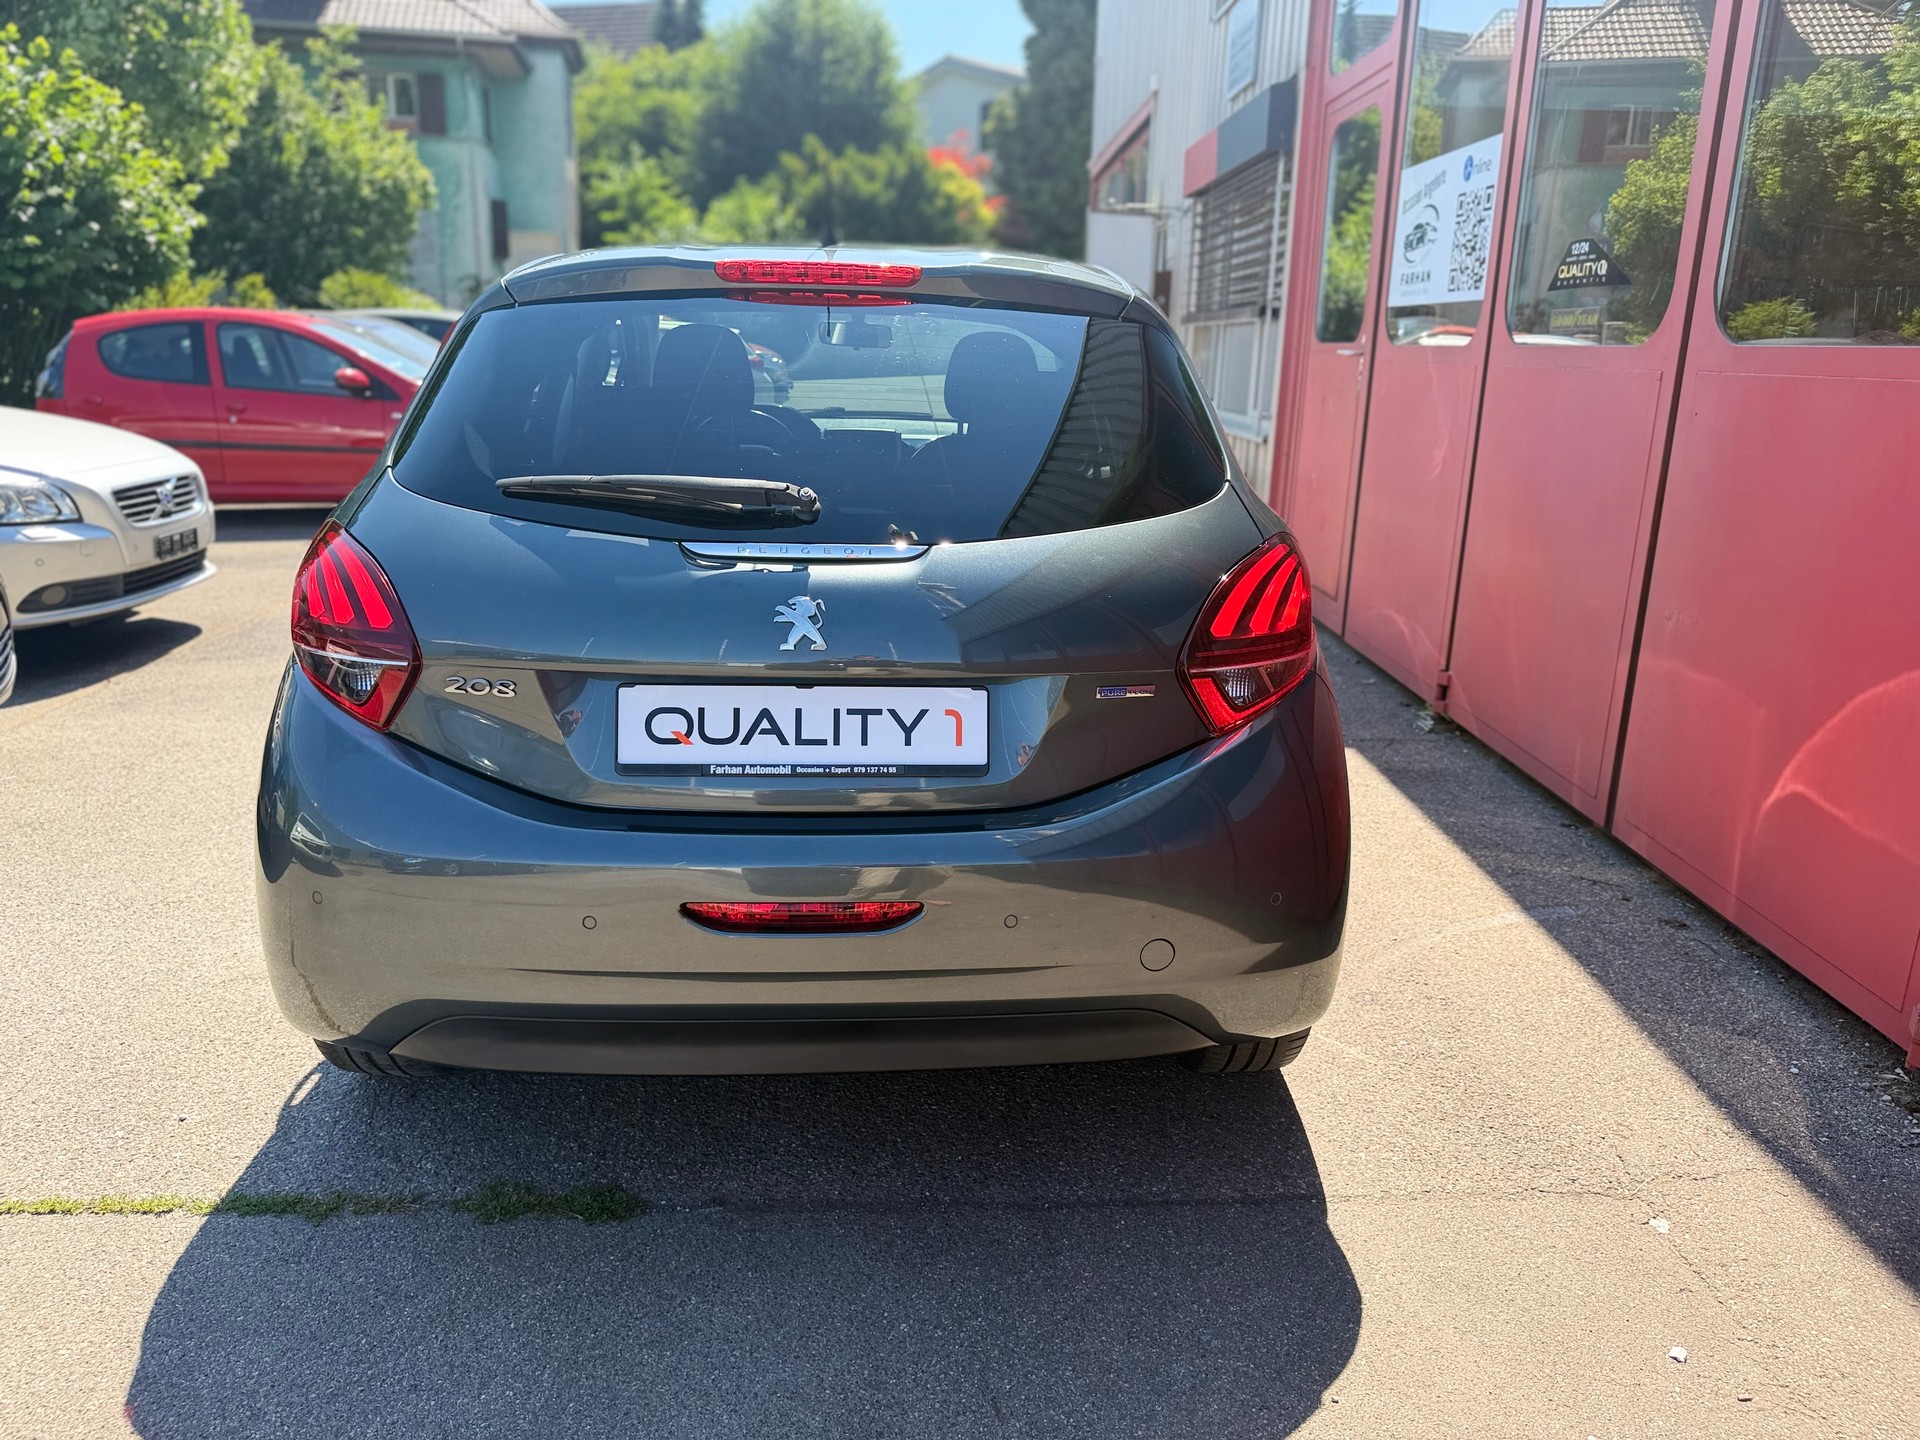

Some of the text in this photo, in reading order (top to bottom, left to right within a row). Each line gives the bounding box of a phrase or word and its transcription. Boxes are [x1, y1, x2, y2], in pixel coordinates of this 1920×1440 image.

[1571, 241, 1590, 255] 12/24
[1400, 270, 1432, 286] FARHAN
[737, 546, 876, 555] PEUGEOT
[444, 675, 517, 698] 208
[644, 706, 963, 747] QUALITY 1
[710, 764, 743, 774] Farhan
[744, 764, 791, 774] Automobil
[796, 766, 824, 774] Occasion
[831, 766, 851, 775] Export
